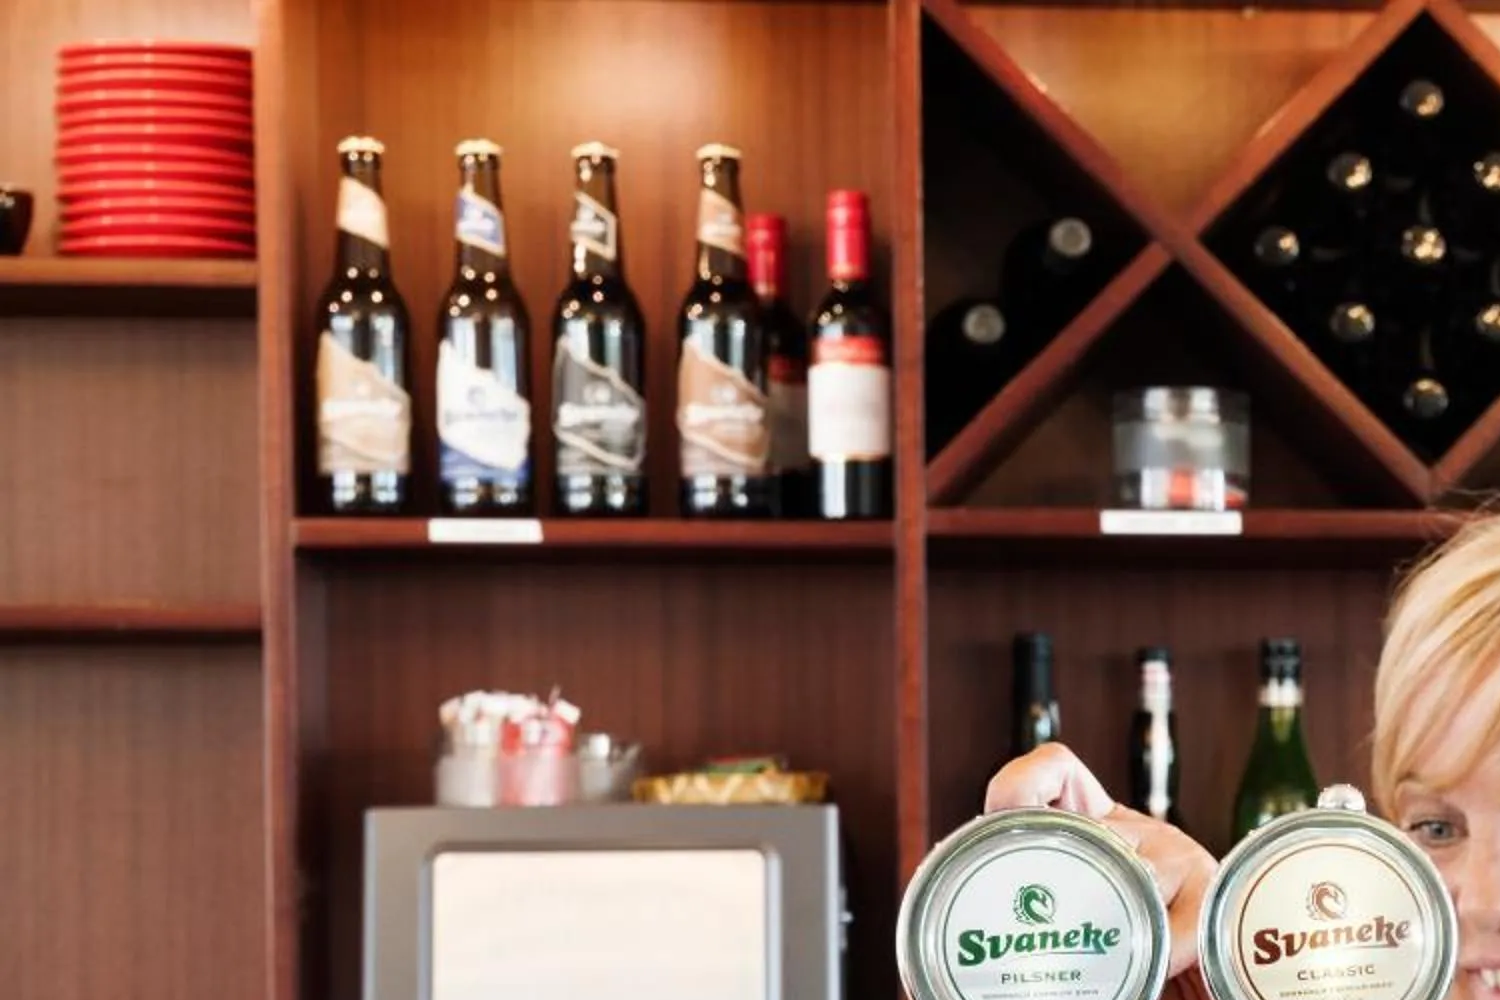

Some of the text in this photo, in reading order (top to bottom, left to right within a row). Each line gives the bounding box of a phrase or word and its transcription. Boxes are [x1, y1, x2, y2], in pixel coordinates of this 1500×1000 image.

[958, 921, 1121, 967] Svaneke
[1254, 916, 1411, 965] Svaneke
[1001, 970, 1083, 985] PILSNER
[1297, 964, 1376, 981] CLASSIC
